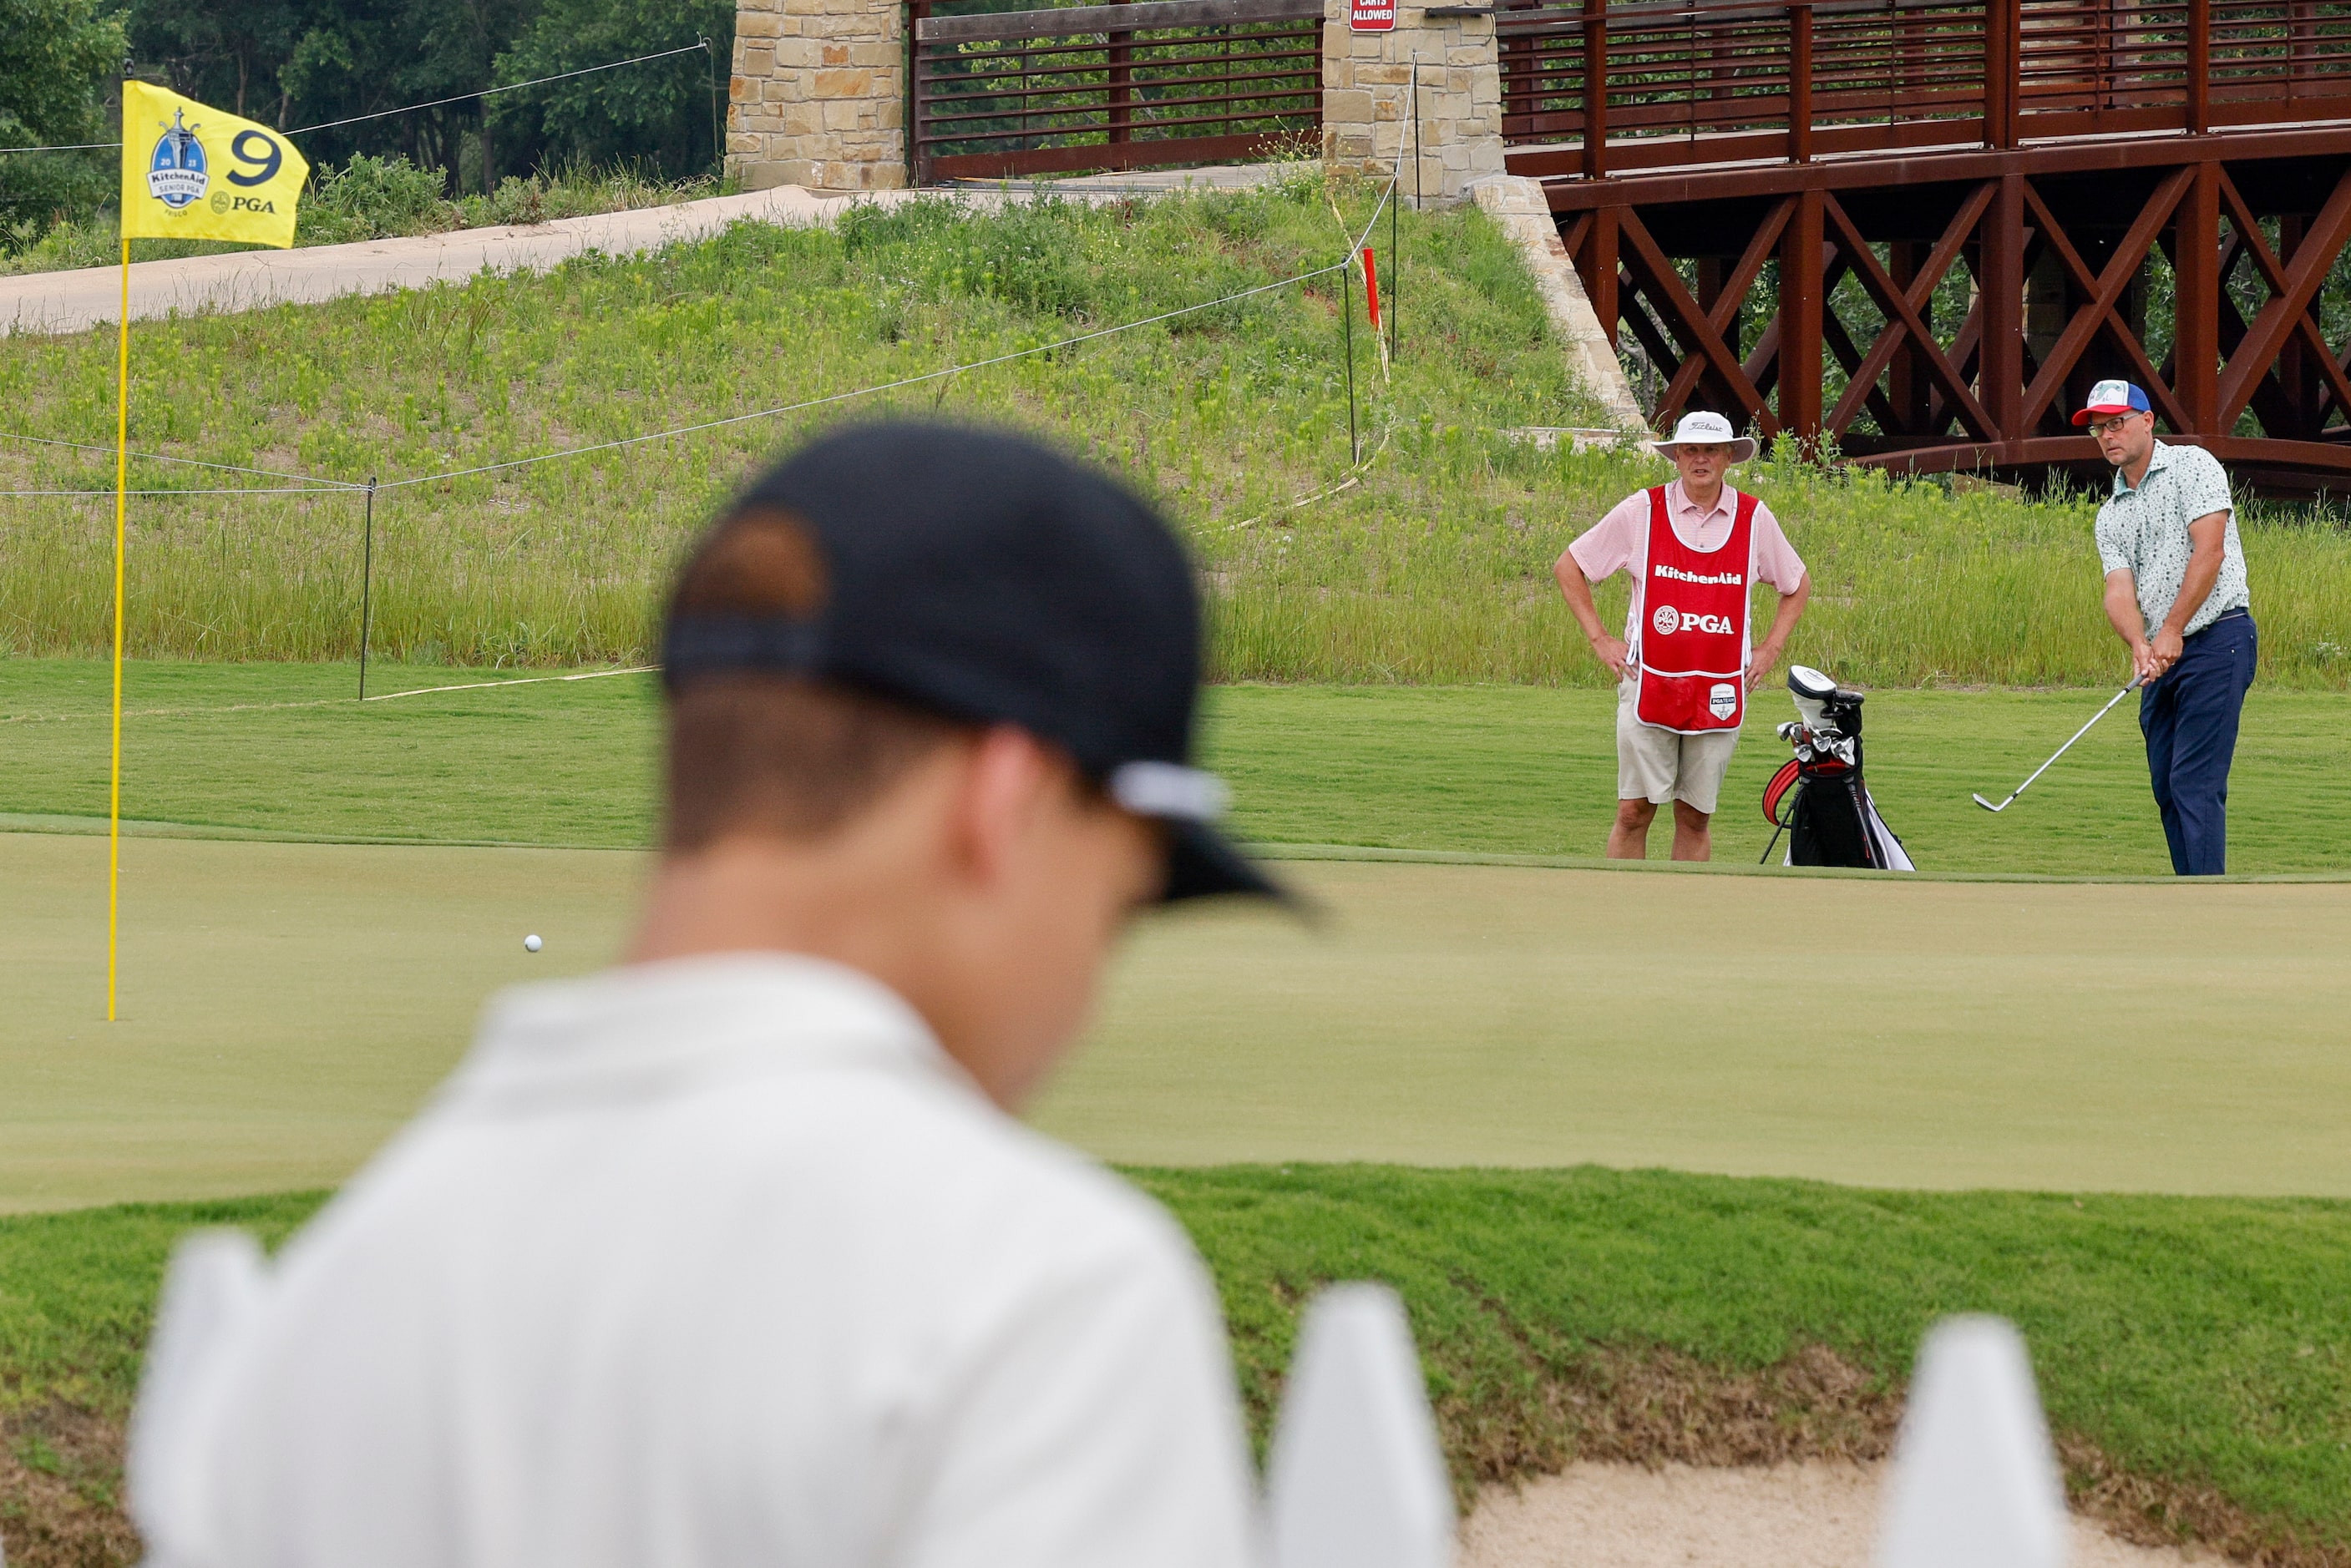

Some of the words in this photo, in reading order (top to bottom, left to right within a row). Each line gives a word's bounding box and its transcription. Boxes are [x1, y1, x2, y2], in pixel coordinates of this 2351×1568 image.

[1353, 9, 1392, 20] ALLOWED
[160, 158, 171, 166] 20
[225, 129, 282, 187] 9
[152, 172, 205, 185] KitchenAid
[159, 184, 185, 193] SENIOR
[186, 185, 200, 194] PGA
[231, 196, 276, 214] PGA
[165, 208, 188, 218] FRISCO
[1689, 422, 1723, 432] Titleist
[1654, 564, 1742, 585] KitchenAid
[1680, 612, 1735, 635] PGA
